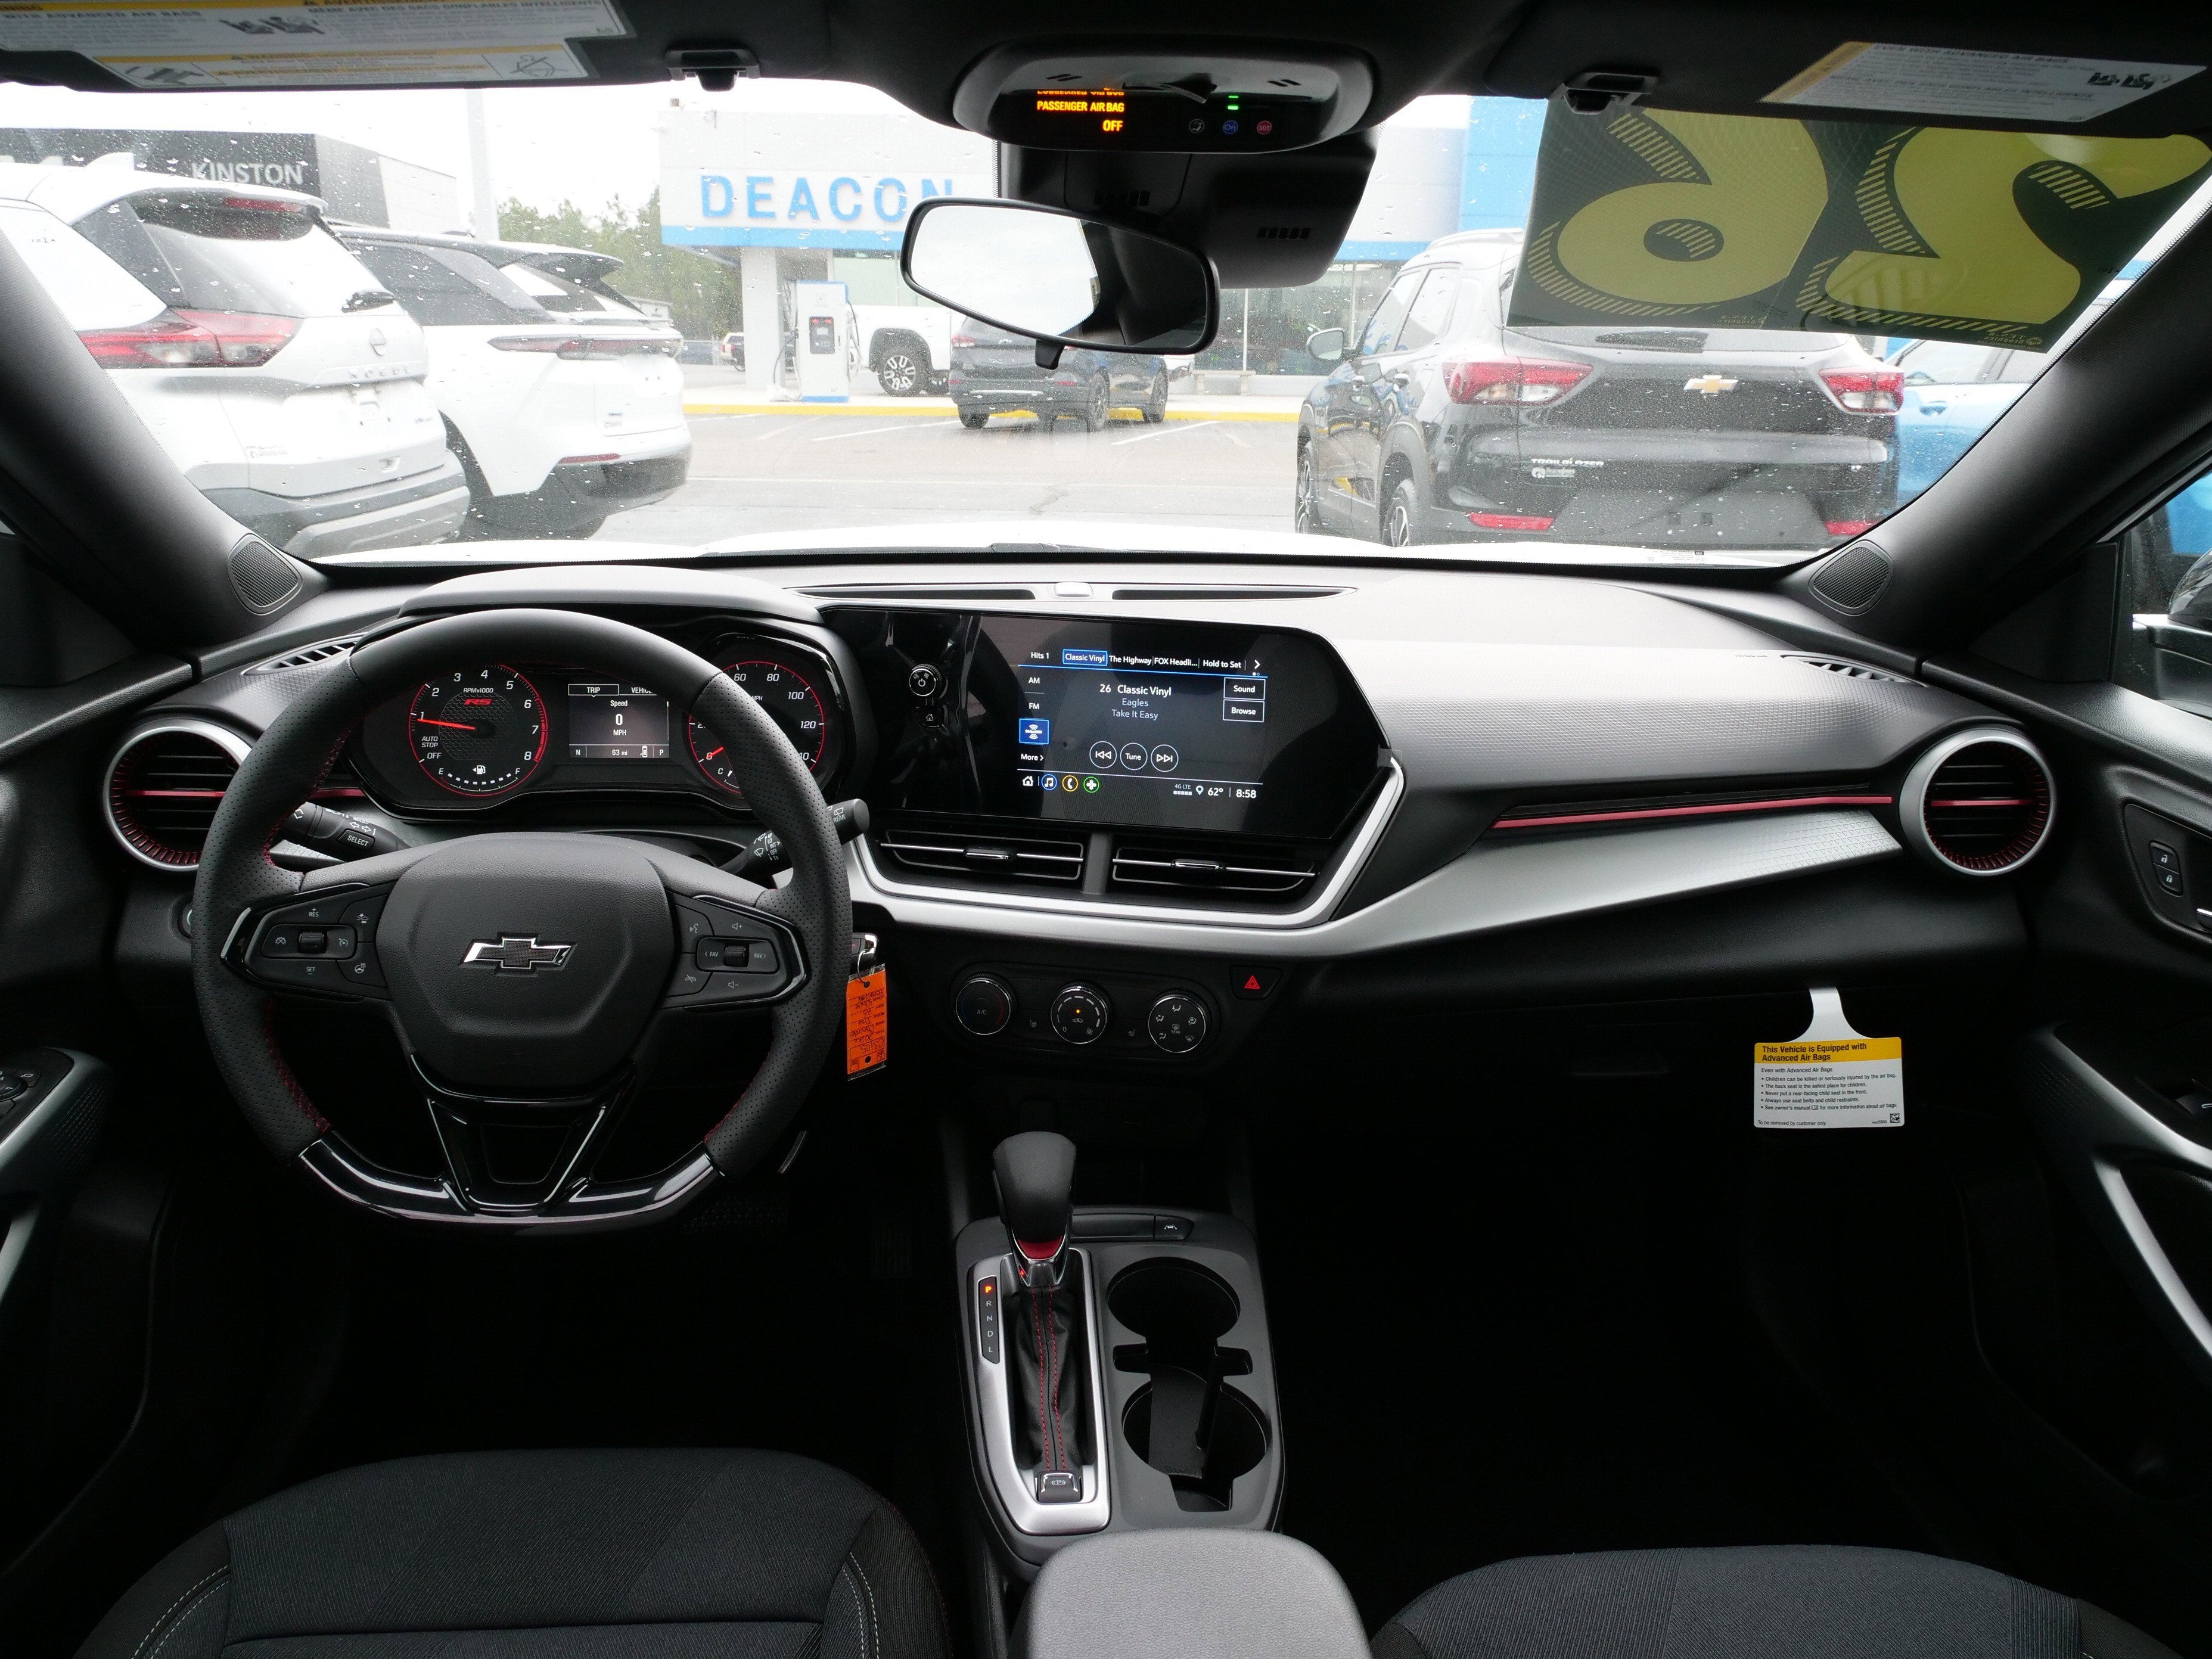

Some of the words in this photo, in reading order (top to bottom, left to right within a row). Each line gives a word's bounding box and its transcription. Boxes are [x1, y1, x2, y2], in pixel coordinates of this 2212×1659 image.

[1037, 101, 1088, 111] PASSENGER
[1090, 102, 1105, 111] AIR
[1106, 102, 1124, 112] BAG
[1103, 120, 1123, 131] OFF
[191, 162, 303, 185] KINSTON
[1065, 653, 1088, 661] Classic
[1089, 654, 1105, 663] Vinyl
[1123, 656, 1151, 665] Highway
[1170, 658, 1198, 666] Headli...
[454, 673, 461, 682] 3
[481, 670, 488, 679] 4
[507, 681, 514, 689] 5
[431, 688, 439, 697] 2
[1117, 685, 1148, 695] Classic
[1150, 686, 1172, 697] Vinyl
[524, 700, 532, 709] 6
[1122, 698, 1148, 707] Eagles
[421, 712, 424, 720] 1
[1112, 709, 1130, 717] Take
[1140, 711, 1158, 720] Easy
[1231, 707, 1256, 716] Browse
[616, 714, 623, 725] 0
[532, 725, 539, 734] 7
[524, 751, 532, 760] 8
[1236, 789, 1256, 799] 8:58
[347, 835, 369, 847] SELECT
[1817, 1044, 1849, 1053] Equipped
